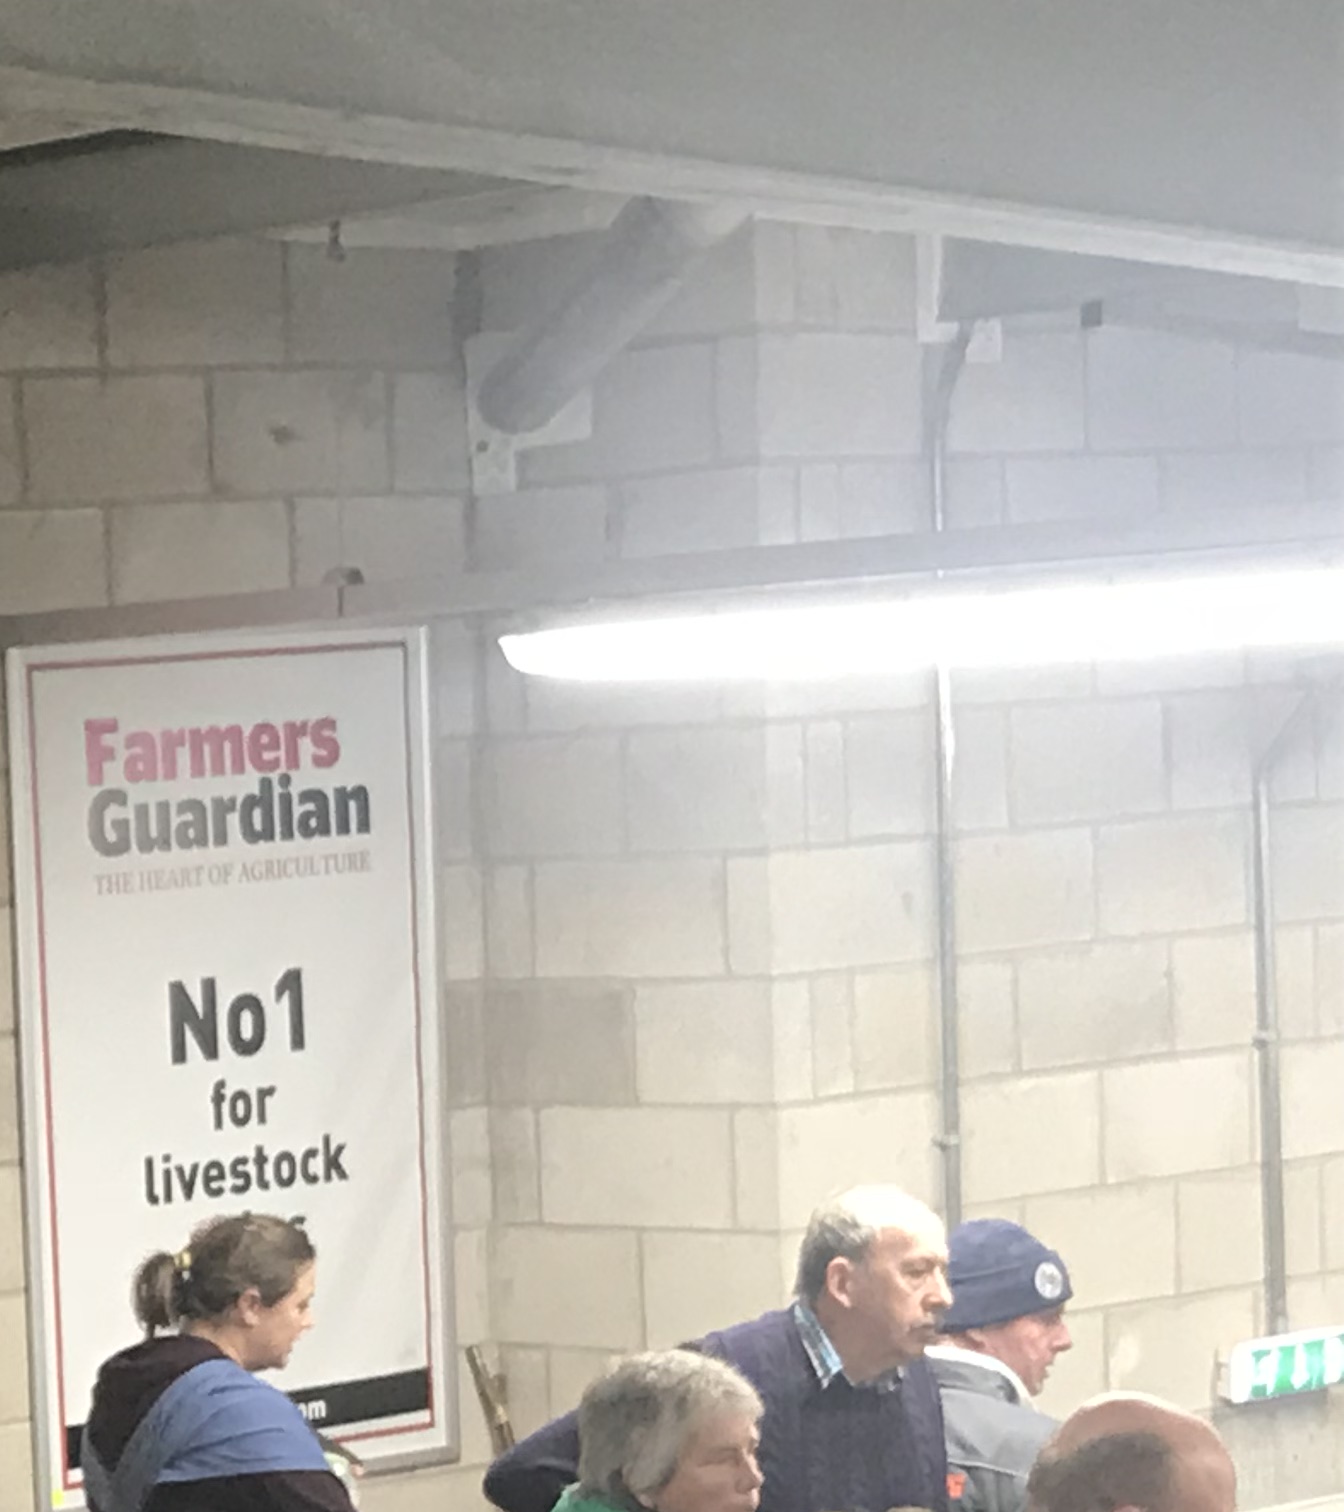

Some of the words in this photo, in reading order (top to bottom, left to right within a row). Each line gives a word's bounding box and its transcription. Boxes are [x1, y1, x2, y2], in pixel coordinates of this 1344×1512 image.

[84, 716, 341, 786] Farmers
[88, 774, 372, 858] Guardian
[94, 872, 134, 896] THE
[138, 864, 205, 893] HEART
[207, 861, 233, 887] OF
[237, 849, 372, 884] AGRICULTURE
[167, 967, 306, 1065] No1
[210, 1079, 277, 1131] for
[143, 1133, 349, 1206] livestock
